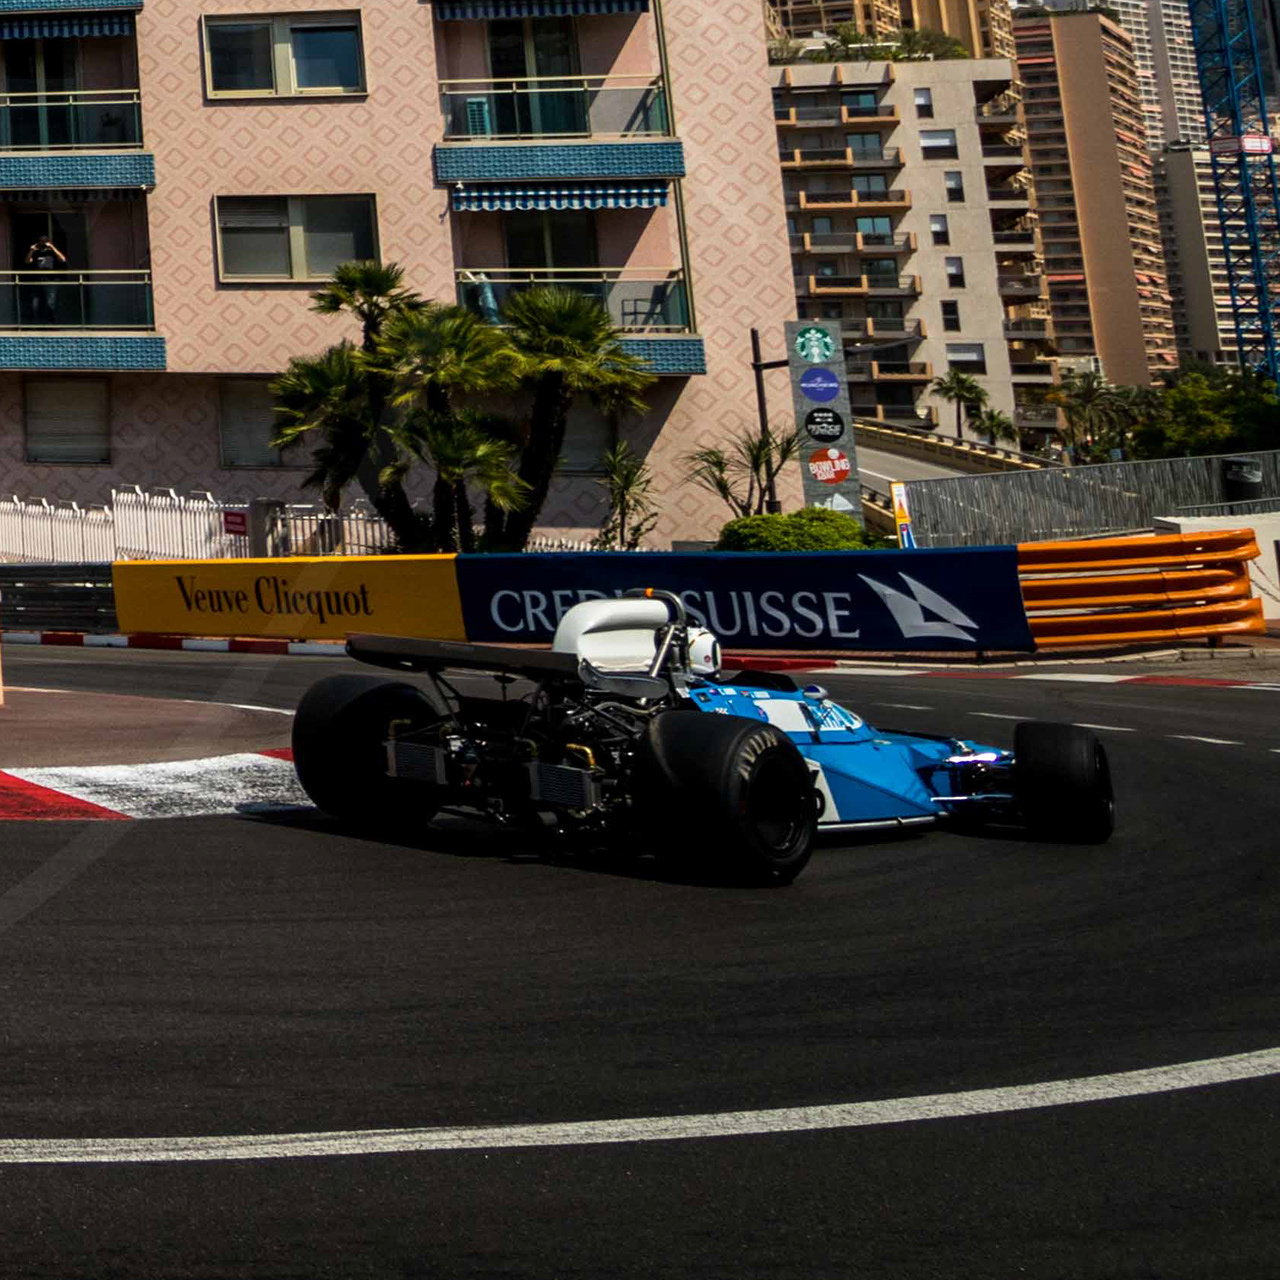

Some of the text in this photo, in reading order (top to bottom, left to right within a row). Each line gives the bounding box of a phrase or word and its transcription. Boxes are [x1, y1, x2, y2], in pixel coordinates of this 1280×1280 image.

[809, 458, 850, 475] BOWLING
[175, 576, 375, 624] Veuve Clicquot
[490, 588, 861, 640] CRE SUISSE
